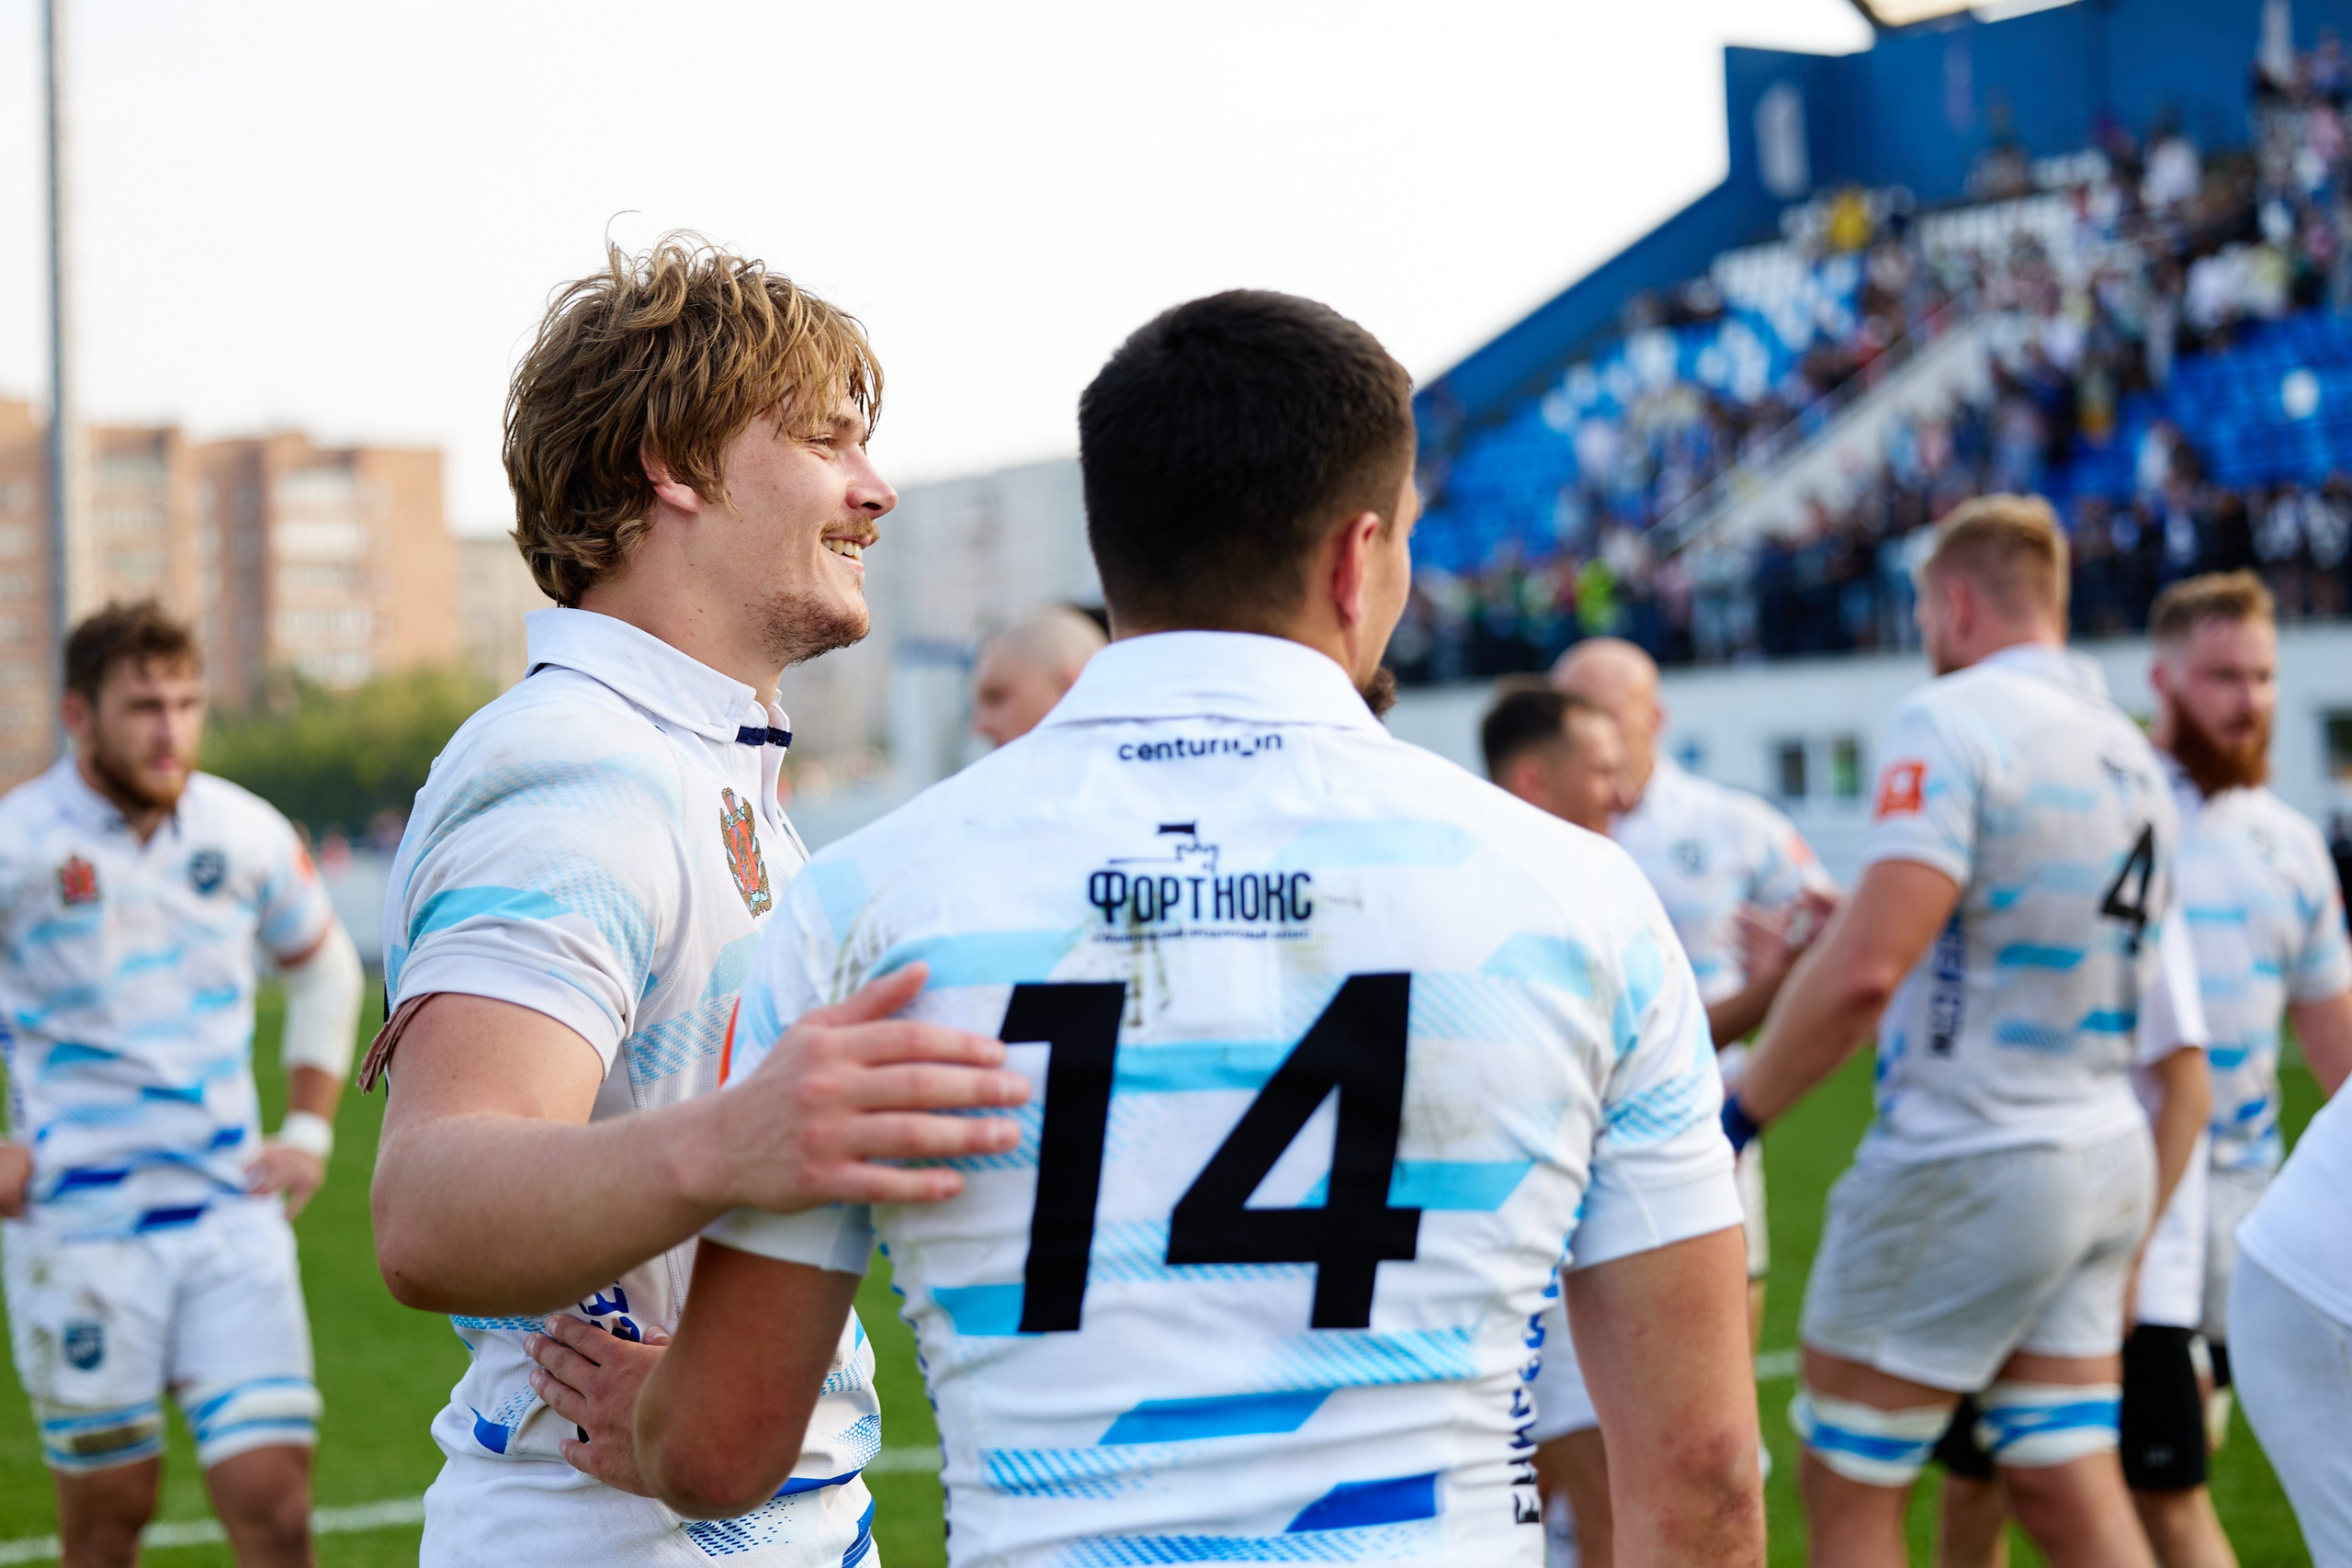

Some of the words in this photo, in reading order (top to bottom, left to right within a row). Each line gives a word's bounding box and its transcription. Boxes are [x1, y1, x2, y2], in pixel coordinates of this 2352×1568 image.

[1088, 871, 1312, 923] ФОРТНОКС
[2099, 822, 2154, 955] 4
[998, 971, 1423, 1332] 14
